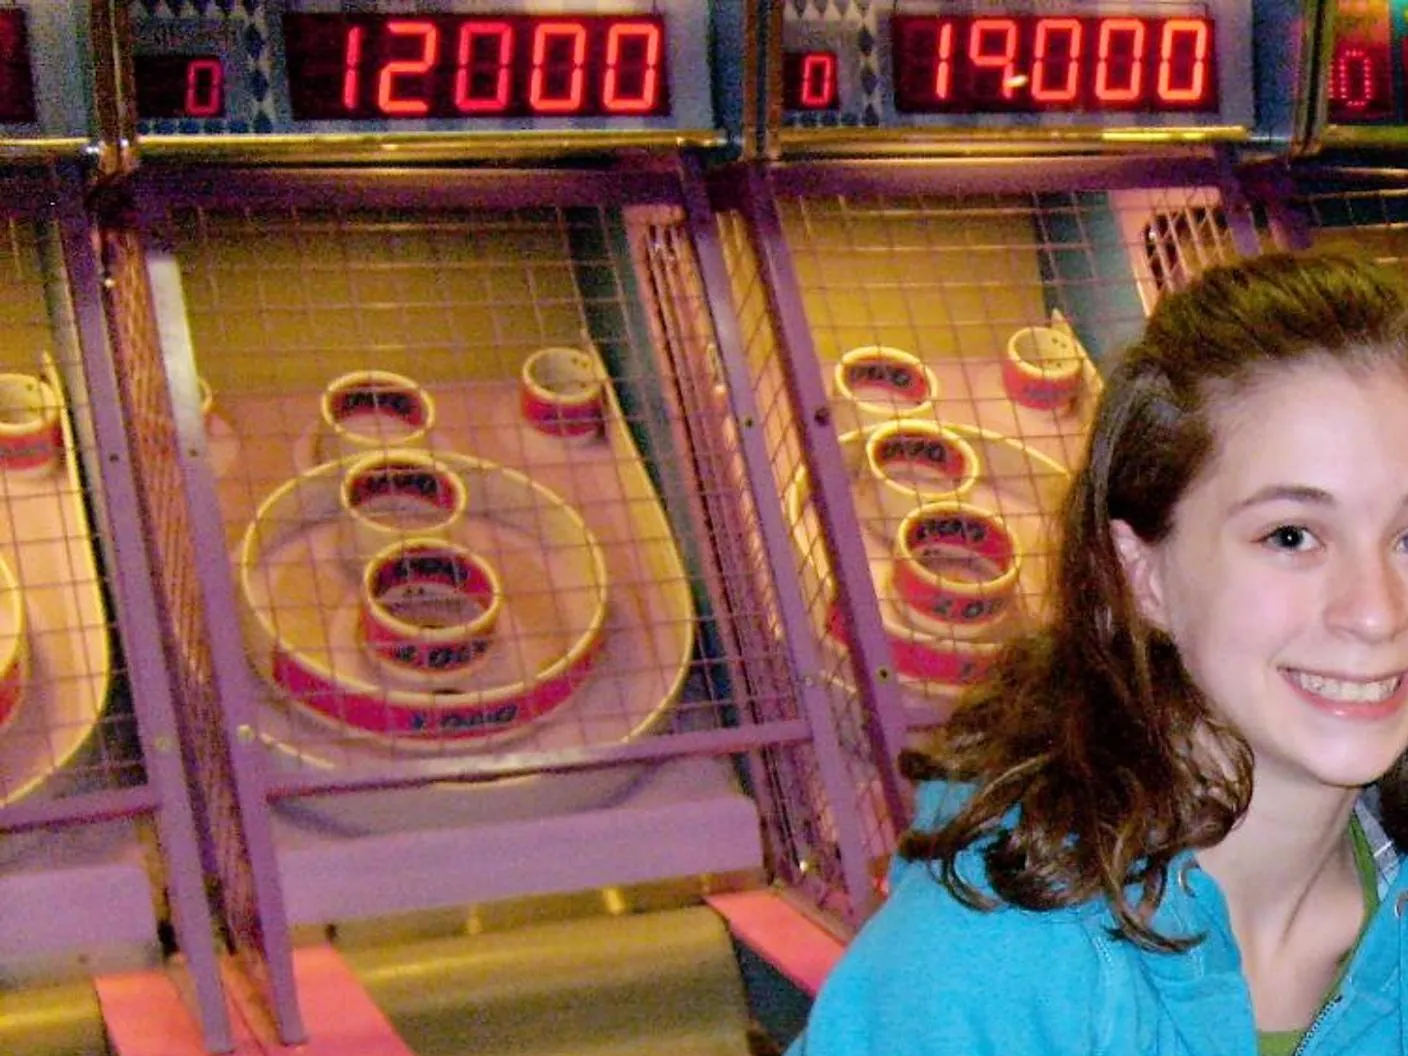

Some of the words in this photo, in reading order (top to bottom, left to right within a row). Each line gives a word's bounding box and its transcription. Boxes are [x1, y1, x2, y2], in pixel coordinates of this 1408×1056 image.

[186, 59, 223, 117] 0
[342, 21, 660, 113] 12000
[802, 54, 832, 107] 0
